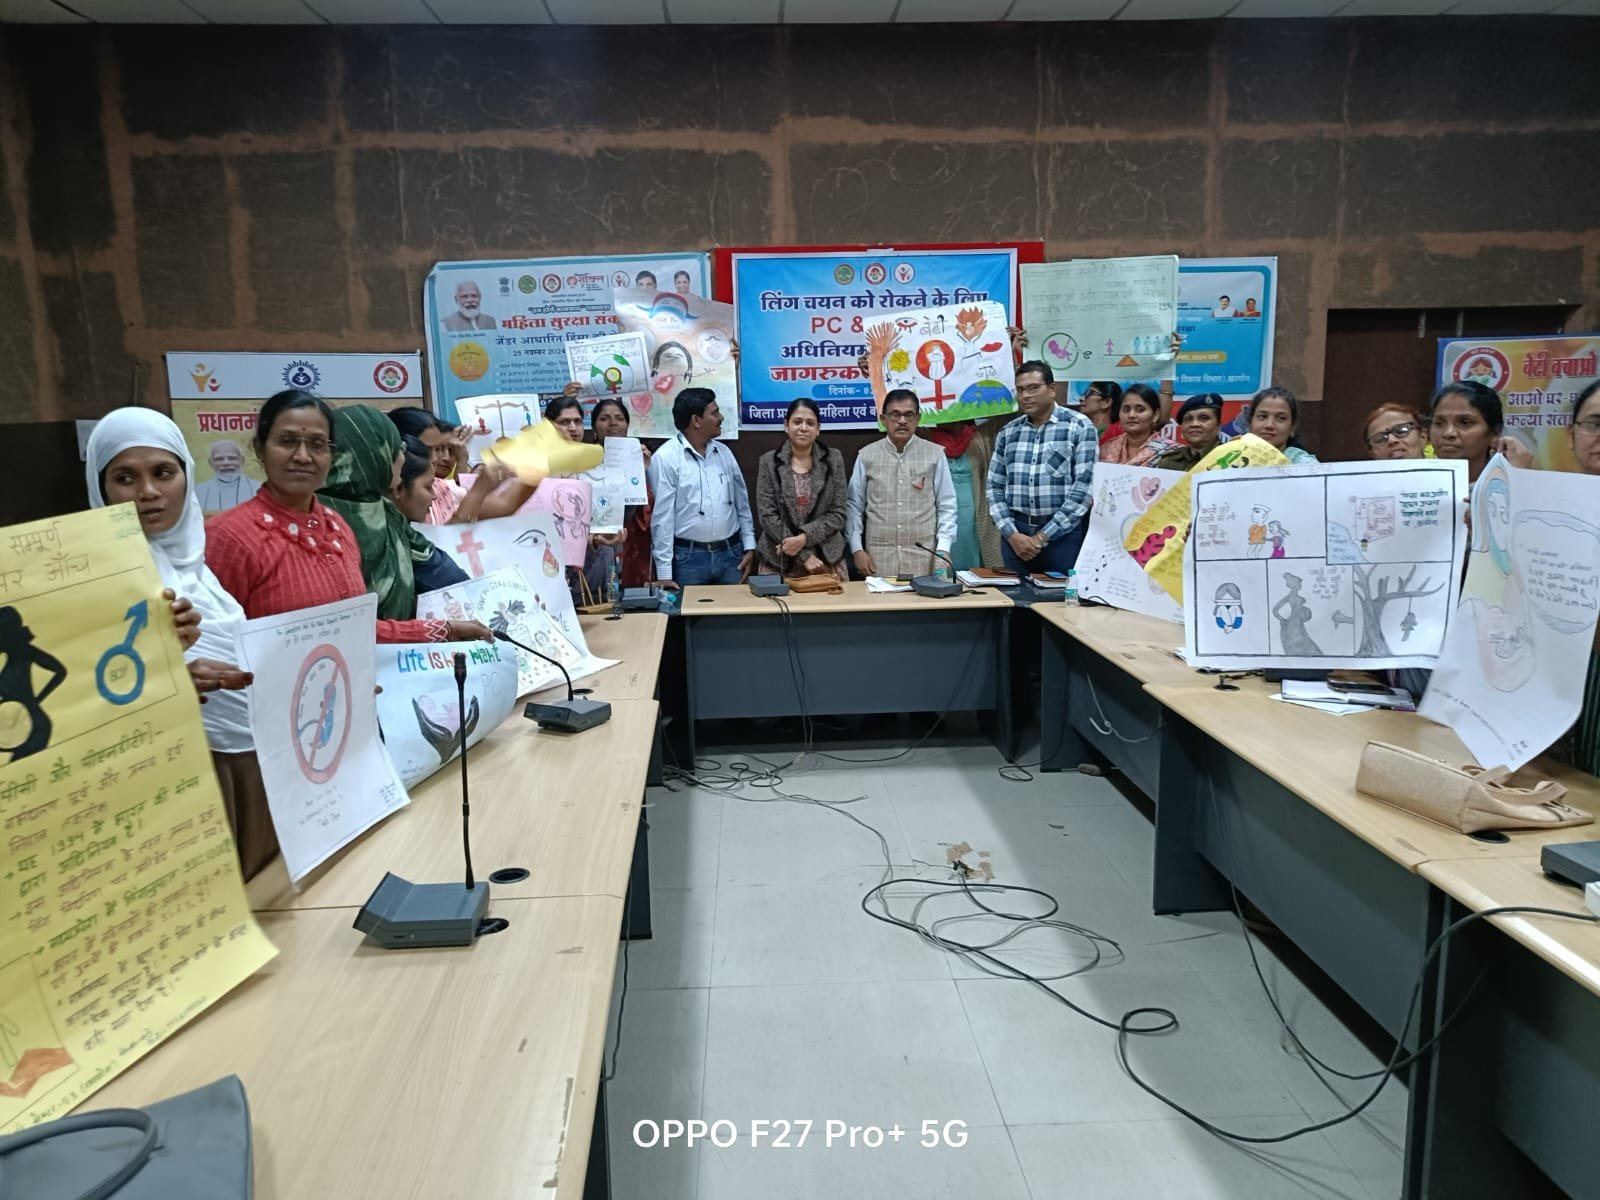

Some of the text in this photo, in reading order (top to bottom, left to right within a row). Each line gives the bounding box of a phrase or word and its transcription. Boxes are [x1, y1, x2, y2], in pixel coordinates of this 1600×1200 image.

[761, 290, 798, 311] लिंग
[804, 295, 845, 310] चयन
[851, 290, 874, 310] को
[879, 288, 927, 309] रोकने
[931, 288, 949, 307] के
[550, 314, 590, 330] सुरक्षा
[811, 315, 864, 334] PC &
[520, 333, 562, 345] आधारित
[1523, 350, 1597, 379] बेटी बचाओ
[1508, 388, 1543, 405] आओ
[749, 404, 775, 419] जिला
[819, 404, 850, 418] महिला
[852, 402, 868, 419] एवं
[197, 407, 260, 432] प्रधानमं
[1506, 413, 1544, 426] कन्या
